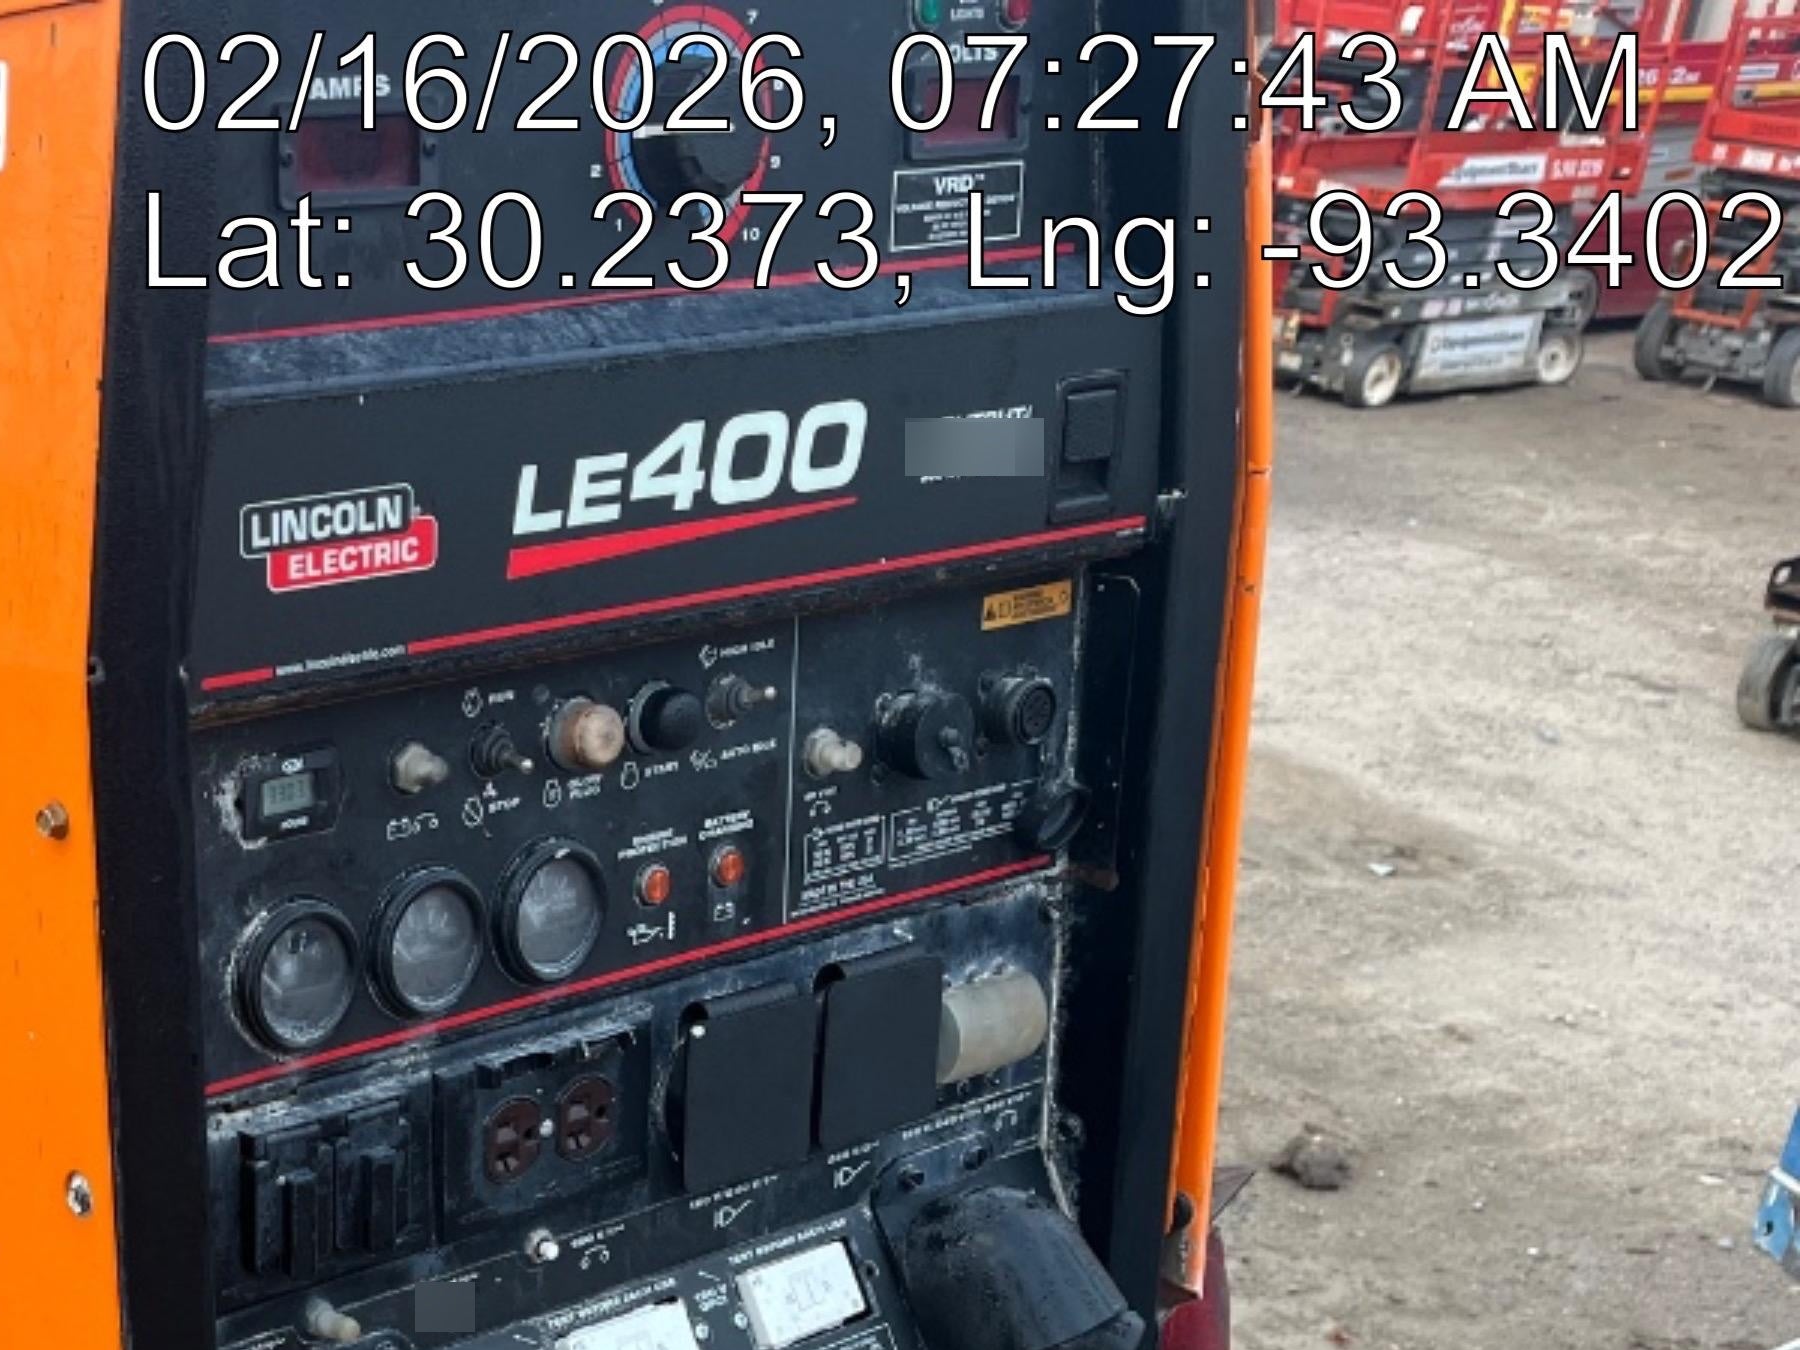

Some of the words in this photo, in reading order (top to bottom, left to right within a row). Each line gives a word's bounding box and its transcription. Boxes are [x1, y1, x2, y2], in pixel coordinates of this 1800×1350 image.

[513, 399, 868, 537] LE400
[251, 494, 405, 548] LINCOLN
[286, 536, 421, 583] ELECTRIC
